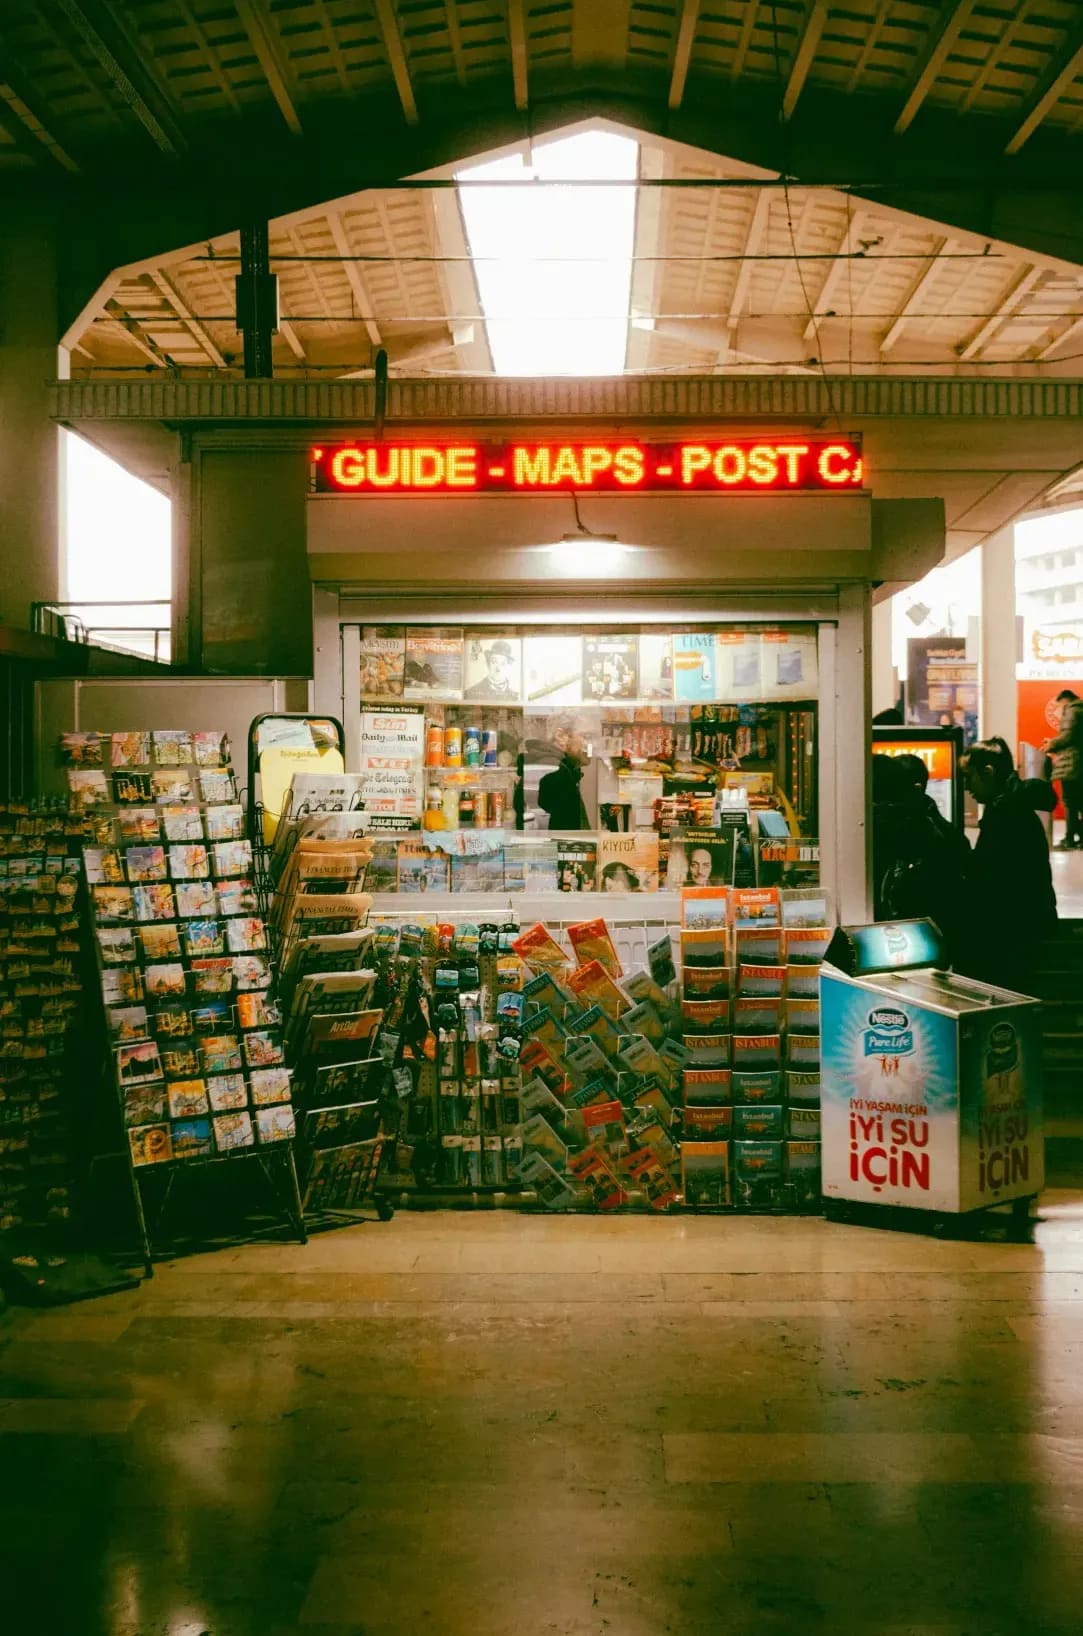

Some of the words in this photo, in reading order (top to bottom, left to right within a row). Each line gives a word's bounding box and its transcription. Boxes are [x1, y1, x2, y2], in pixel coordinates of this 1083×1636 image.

[332, 448, 476, 486] GUIDE
[514, 447, 644, 485] MAPS
[681, 446, 808, 484] POST
[361, 732, 385, 742] Daily
[397, 734, 417, 742] Mail
[868, 1036, 891, 1048] Pure
[892, 1036, 910, 1049] Life
[891, 1118, 929, 1148] SU
[849, 1141, 930, 1192] İÇİN
